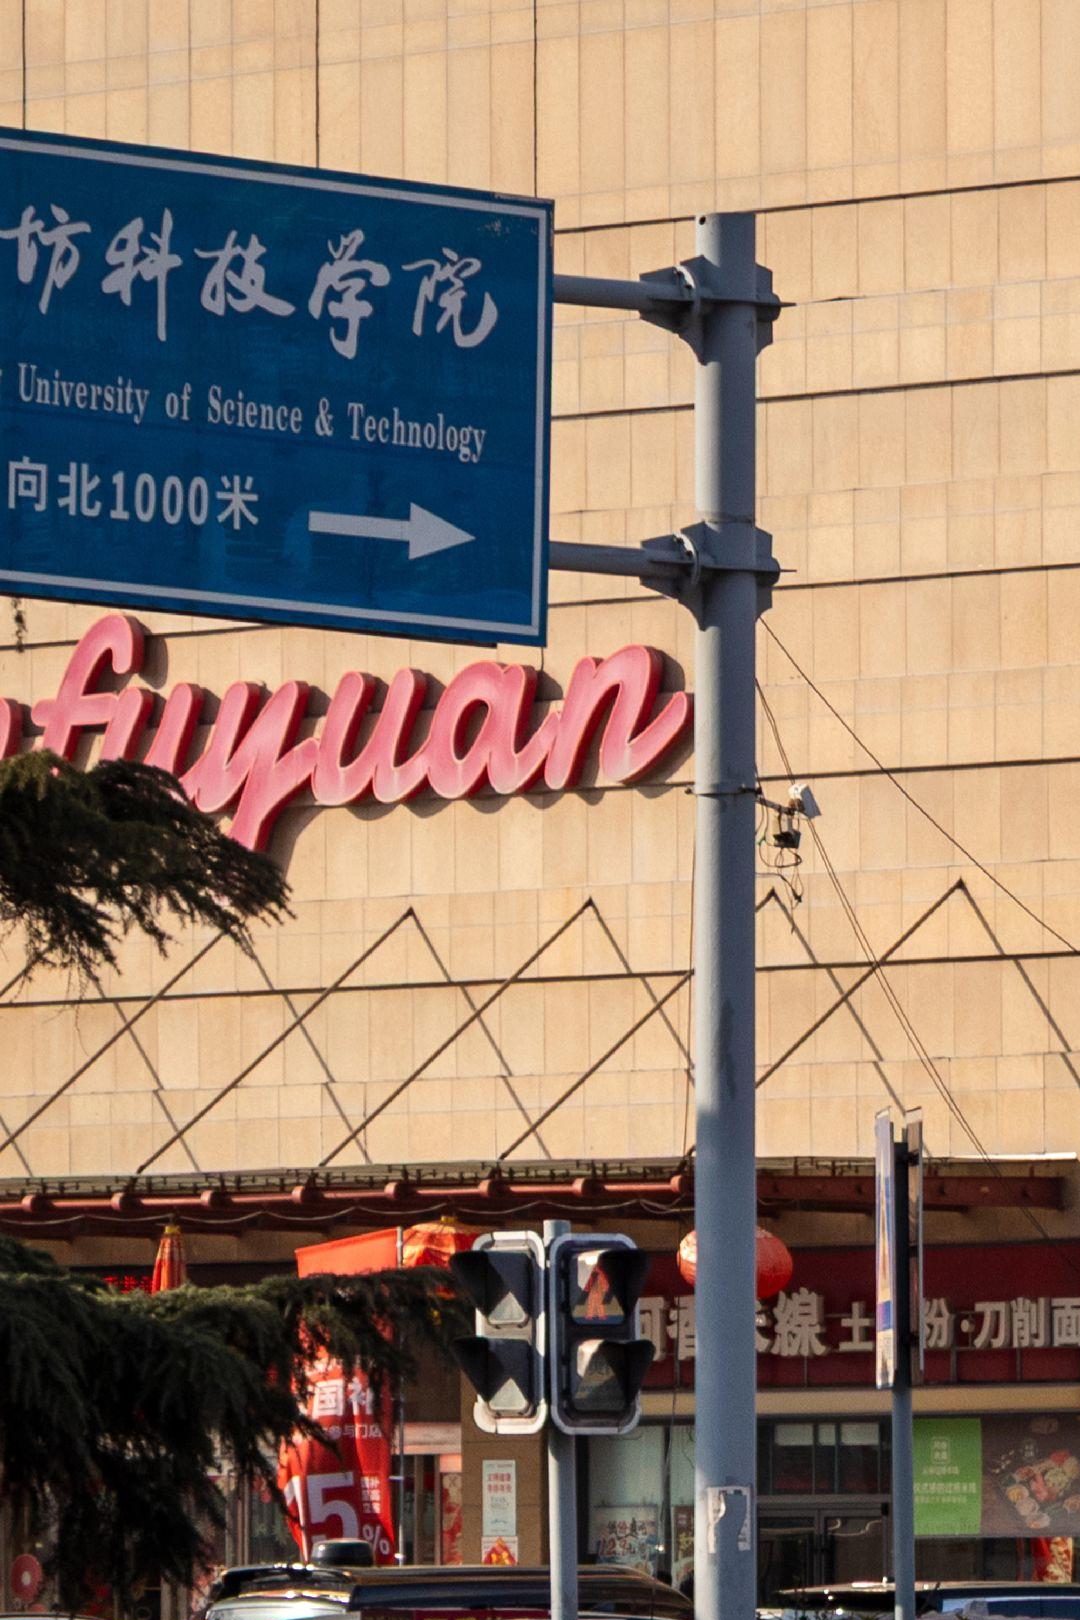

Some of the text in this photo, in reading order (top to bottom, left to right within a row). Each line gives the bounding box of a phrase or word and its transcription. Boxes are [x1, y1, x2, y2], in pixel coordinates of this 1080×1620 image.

[18, 362, 487, 463] University of Science & Technology
[7, 456, 259, 530] 向北1000米
